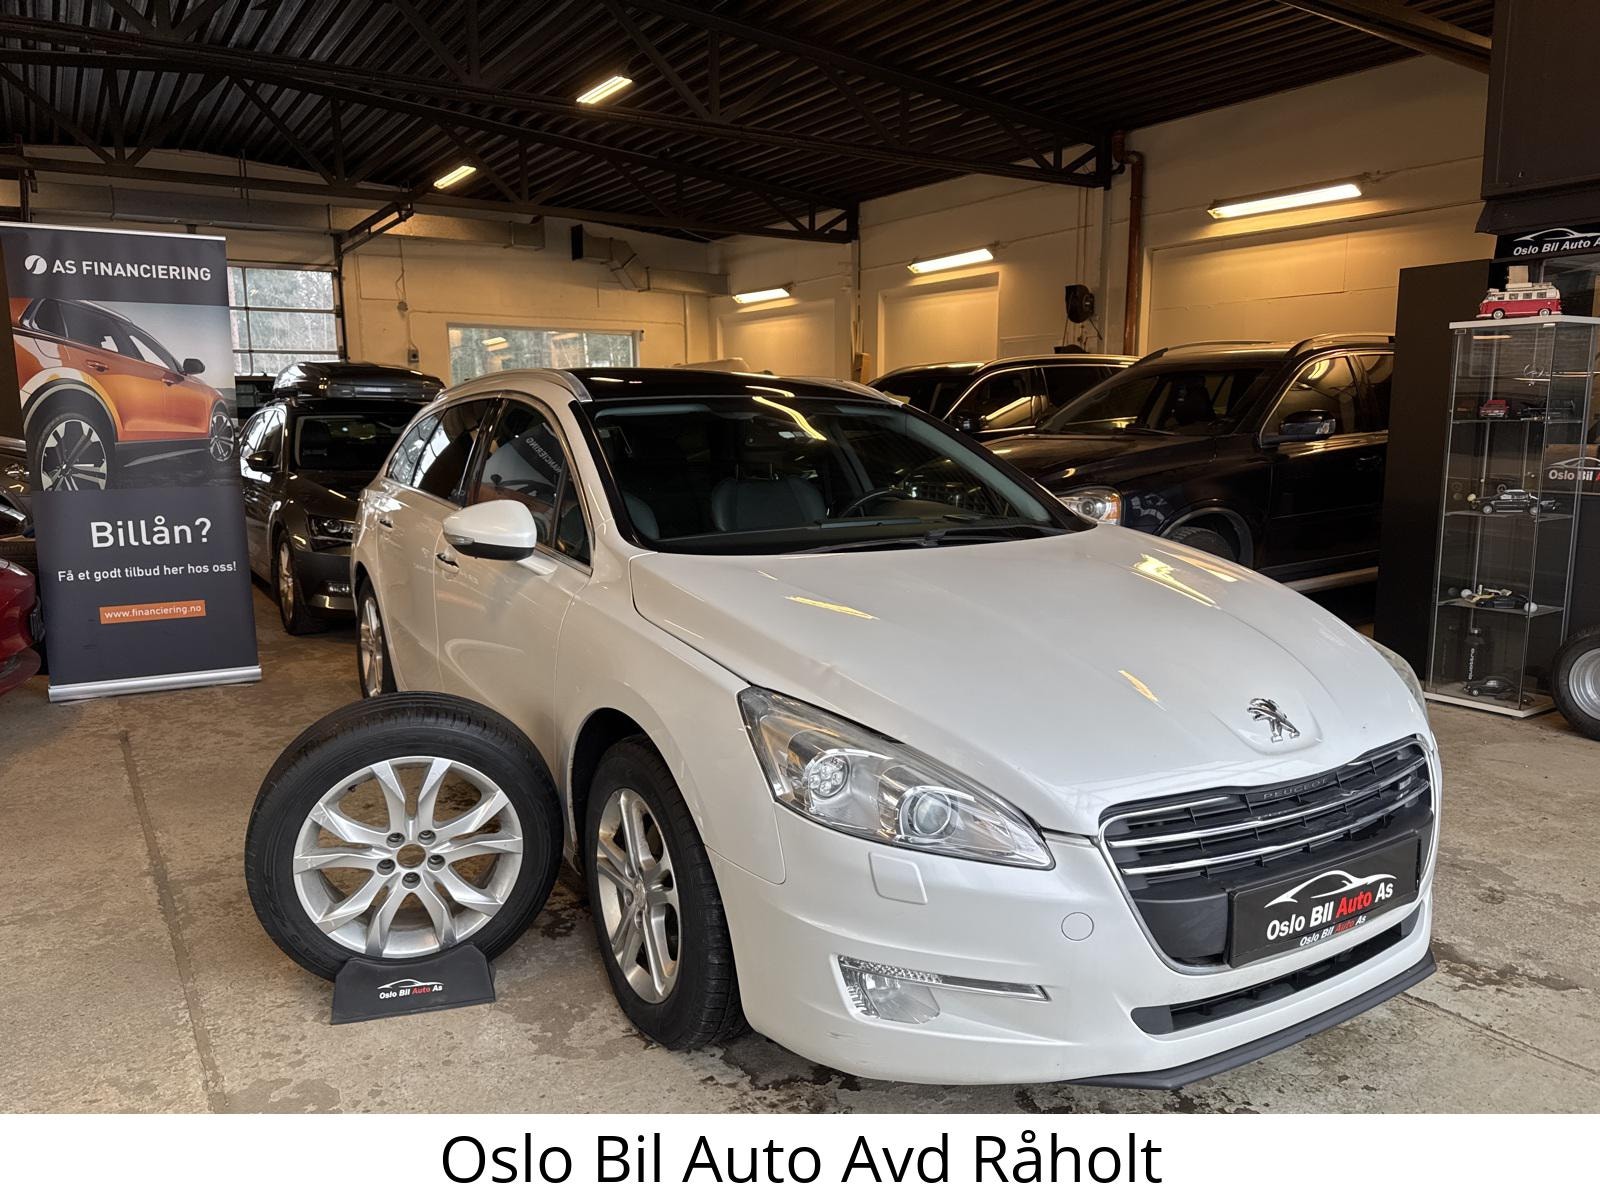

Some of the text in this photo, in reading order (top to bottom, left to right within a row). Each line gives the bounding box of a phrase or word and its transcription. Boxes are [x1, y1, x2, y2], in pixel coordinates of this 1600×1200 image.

[1513, 245, 1539, 256] Oslo
[1561, 240, 1591, 251] Auto
[52, 259, 212, 281] AS FINANCIERING
[1548, 469, 1575, 480] Oslo
[1577, 470, 1594, 481] Bil
[90, 515, 212, 549] Billån?
[58, 560, 237, 582] Få et godt tilbud her hos oss!
[104, 604, 202, 619] www.financiering.no
[1266, 914, 1305, 941] Oslo
[1336, 891, 1372, 918] Auto
[1375, 882, 1394, 903] As
[1300, 915, 1367, 947] Oslo Bil Auto As
[379, 991, 398, 999] Oslo
[412, 986, 431, 995] Auto
[432, 984, 443, 992] As
